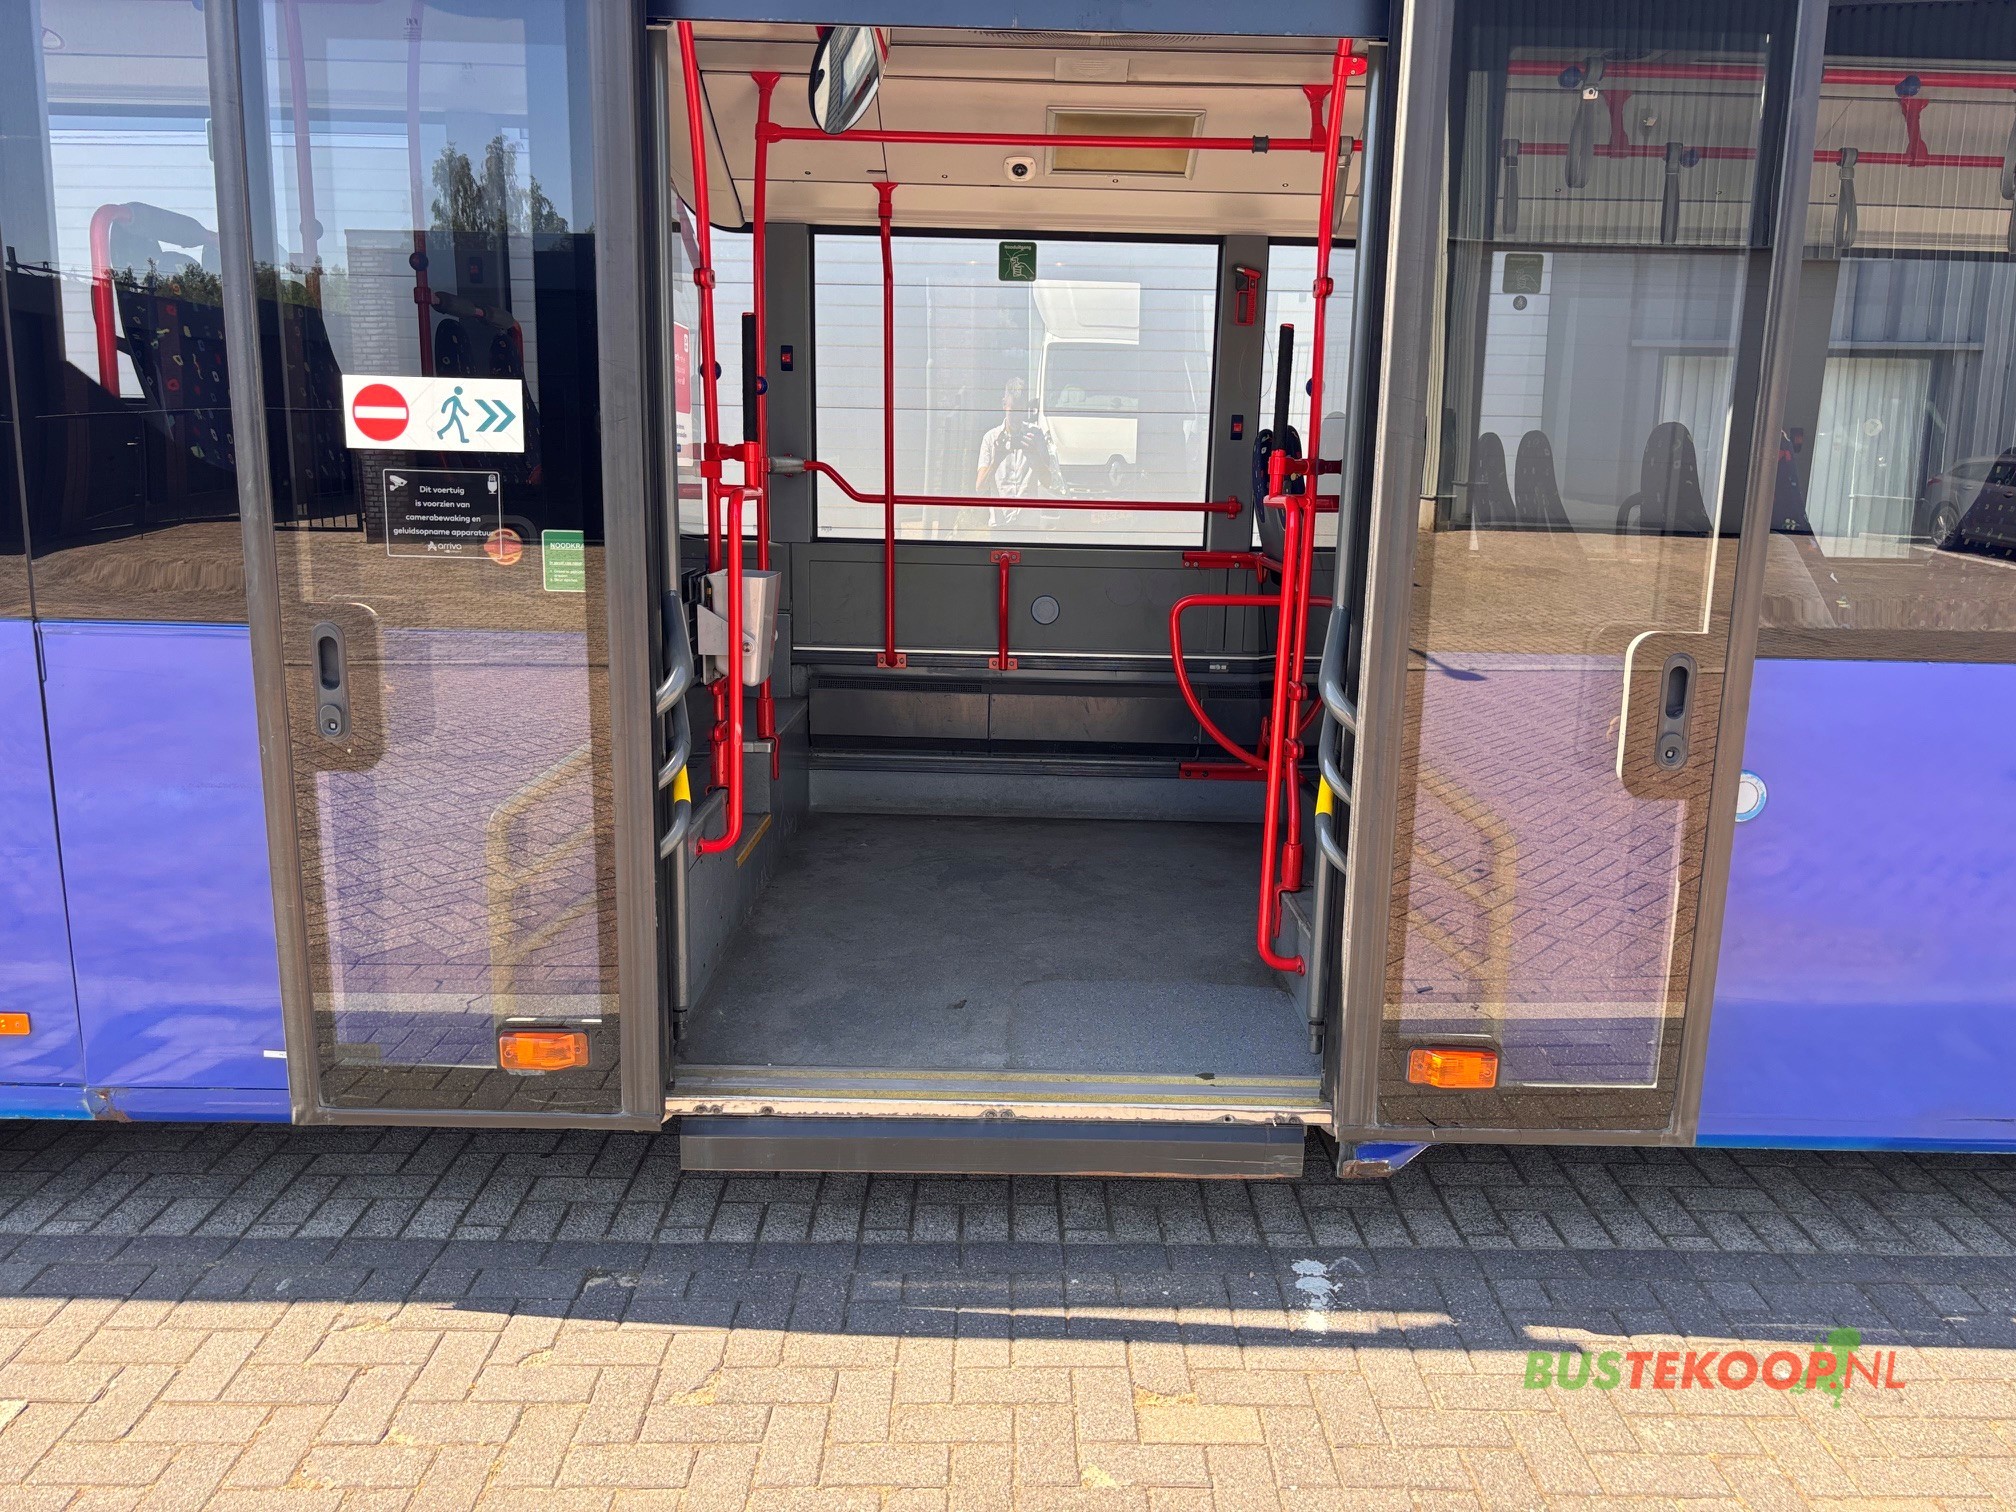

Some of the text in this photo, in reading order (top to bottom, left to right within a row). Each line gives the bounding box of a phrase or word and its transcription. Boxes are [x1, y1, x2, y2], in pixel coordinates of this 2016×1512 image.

[419, 485, 465, 496] Dit voertuig
[422, 500, 455, 508] voorzien
[405, 514, 471, 524] camerabewaking
[393, 527, 450, 537] geluidsopname
[438, 542, 462, 550] arriva
